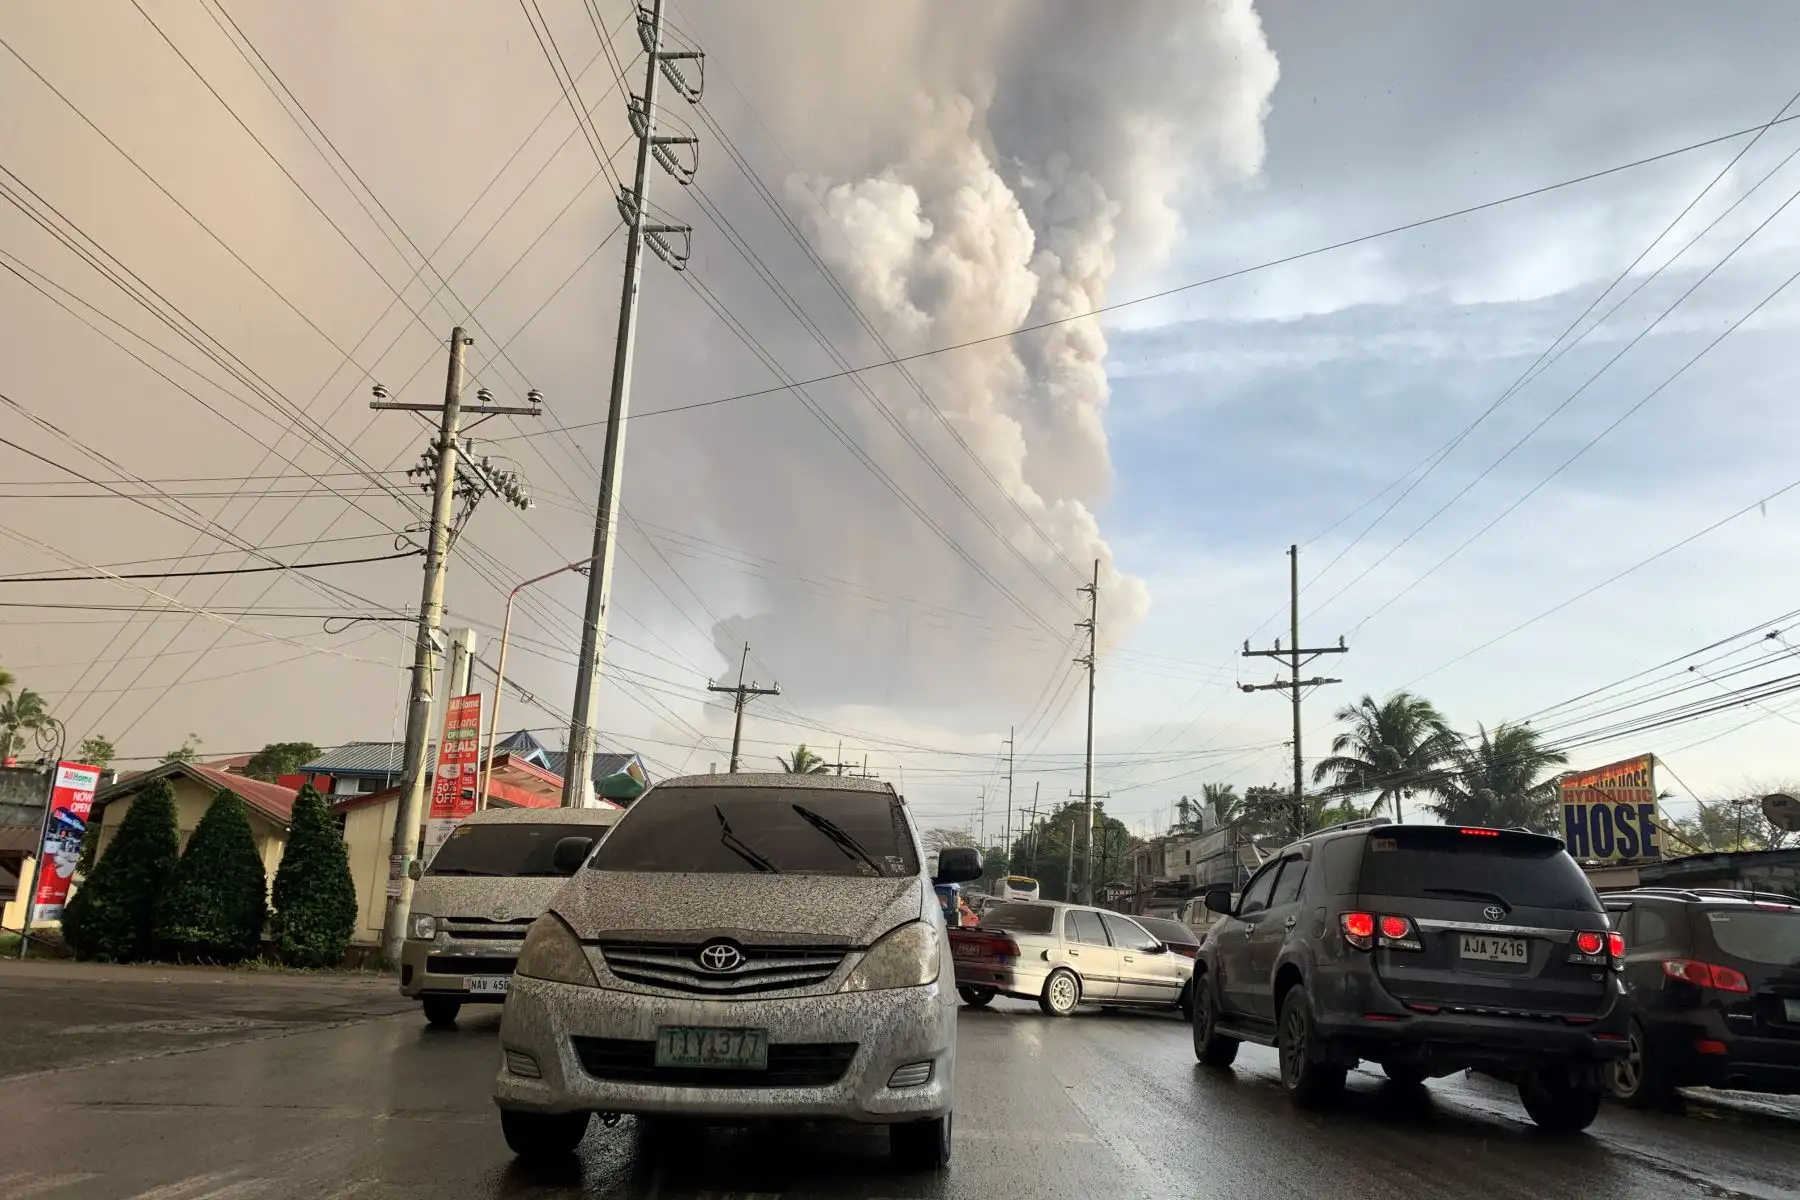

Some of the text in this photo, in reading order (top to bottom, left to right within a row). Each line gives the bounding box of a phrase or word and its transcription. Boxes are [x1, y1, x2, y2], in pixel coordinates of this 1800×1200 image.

[444, 740, 477, 753] DEALS
[436, 781, 457, 793] 50%
[72, 791, 94, 802] NOW
[436, 793, 457, 804] OFF
[1563, 789, 1653, 803] HYDRAULIC
[70, 802, 92, 813] OPEN
[1564, 803, 1659, 858] HOSE
[1464, 938, 1524, 957] AJA 7416
[471, 979, 487, 990] NAV
